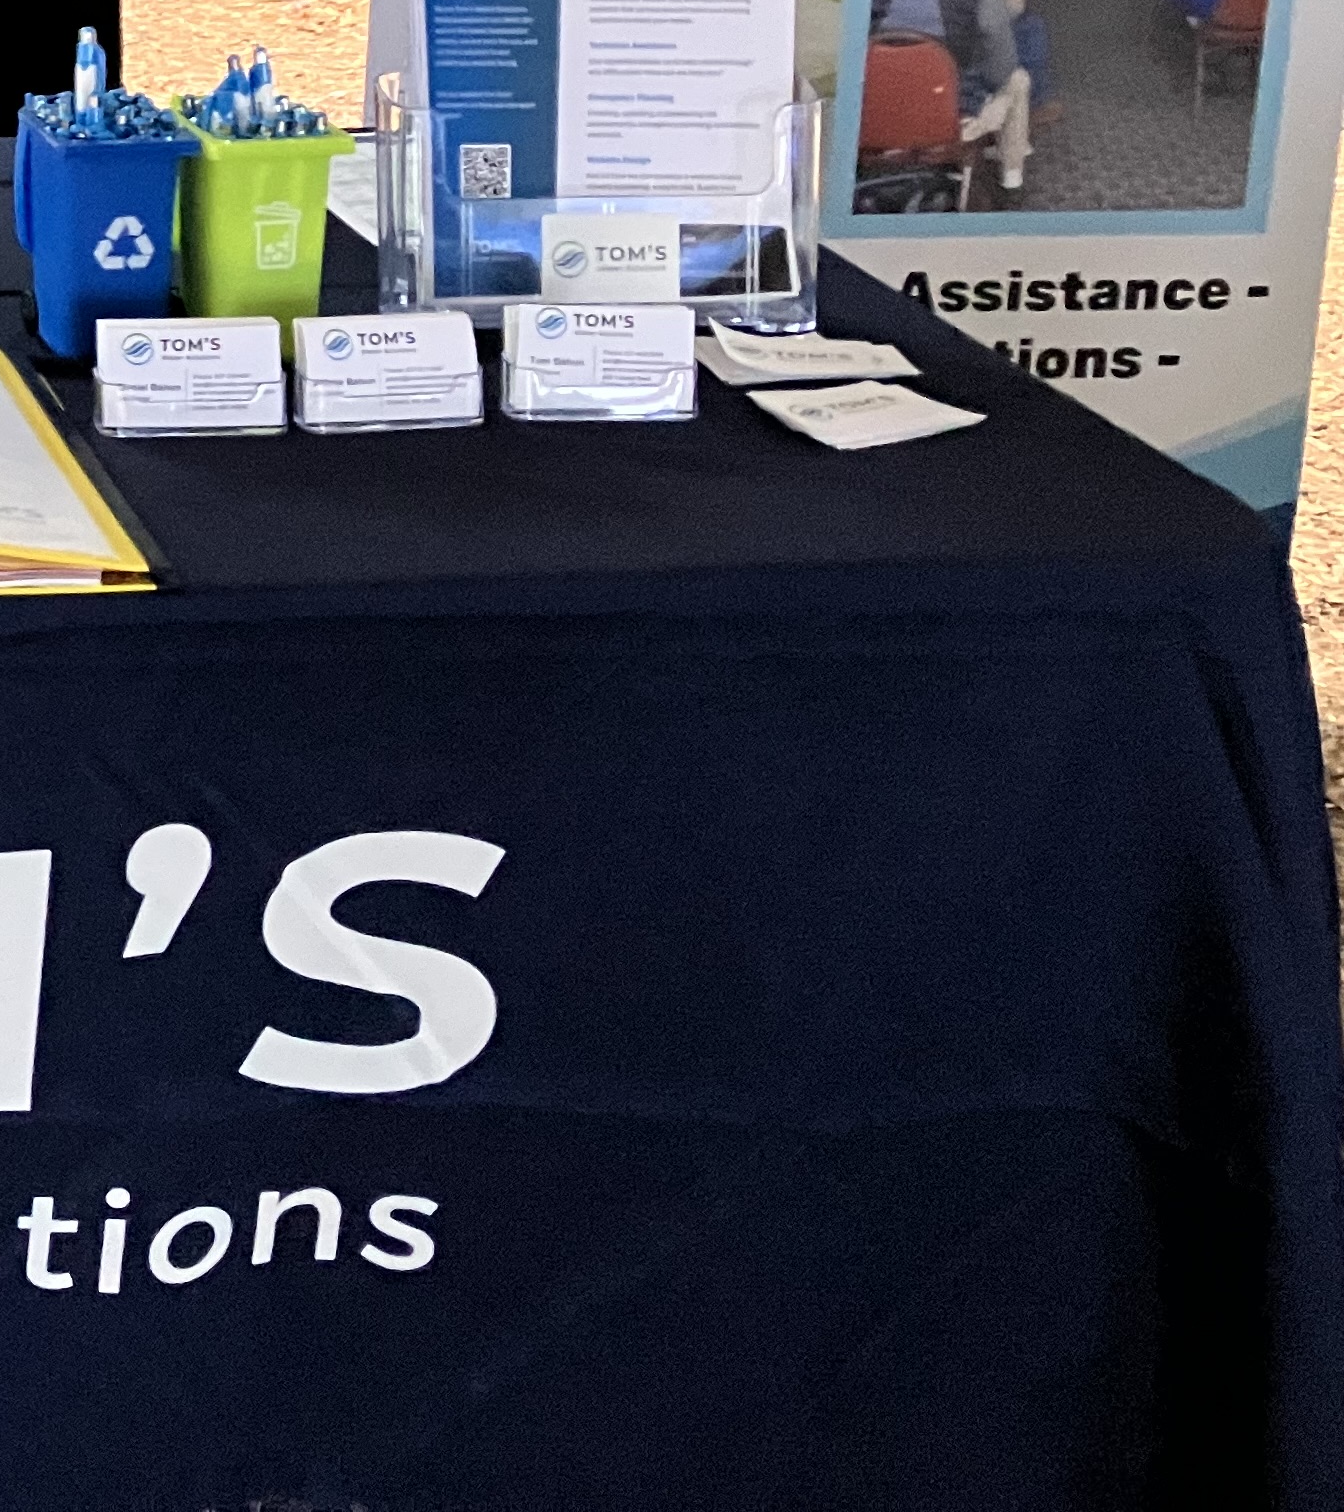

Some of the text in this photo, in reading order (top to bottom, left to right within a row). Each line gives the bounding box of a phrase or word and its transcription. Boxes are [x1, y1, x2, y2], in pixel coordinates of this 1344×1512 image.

[594, 245, 668, 262] TOM'S
[901, 270, 1232, 313] Assistance
[573, 313, 635, 329] TOM'S
[160, 337, 221, 352] TOM'S
[357, 331, 416, 346] TOM'S
